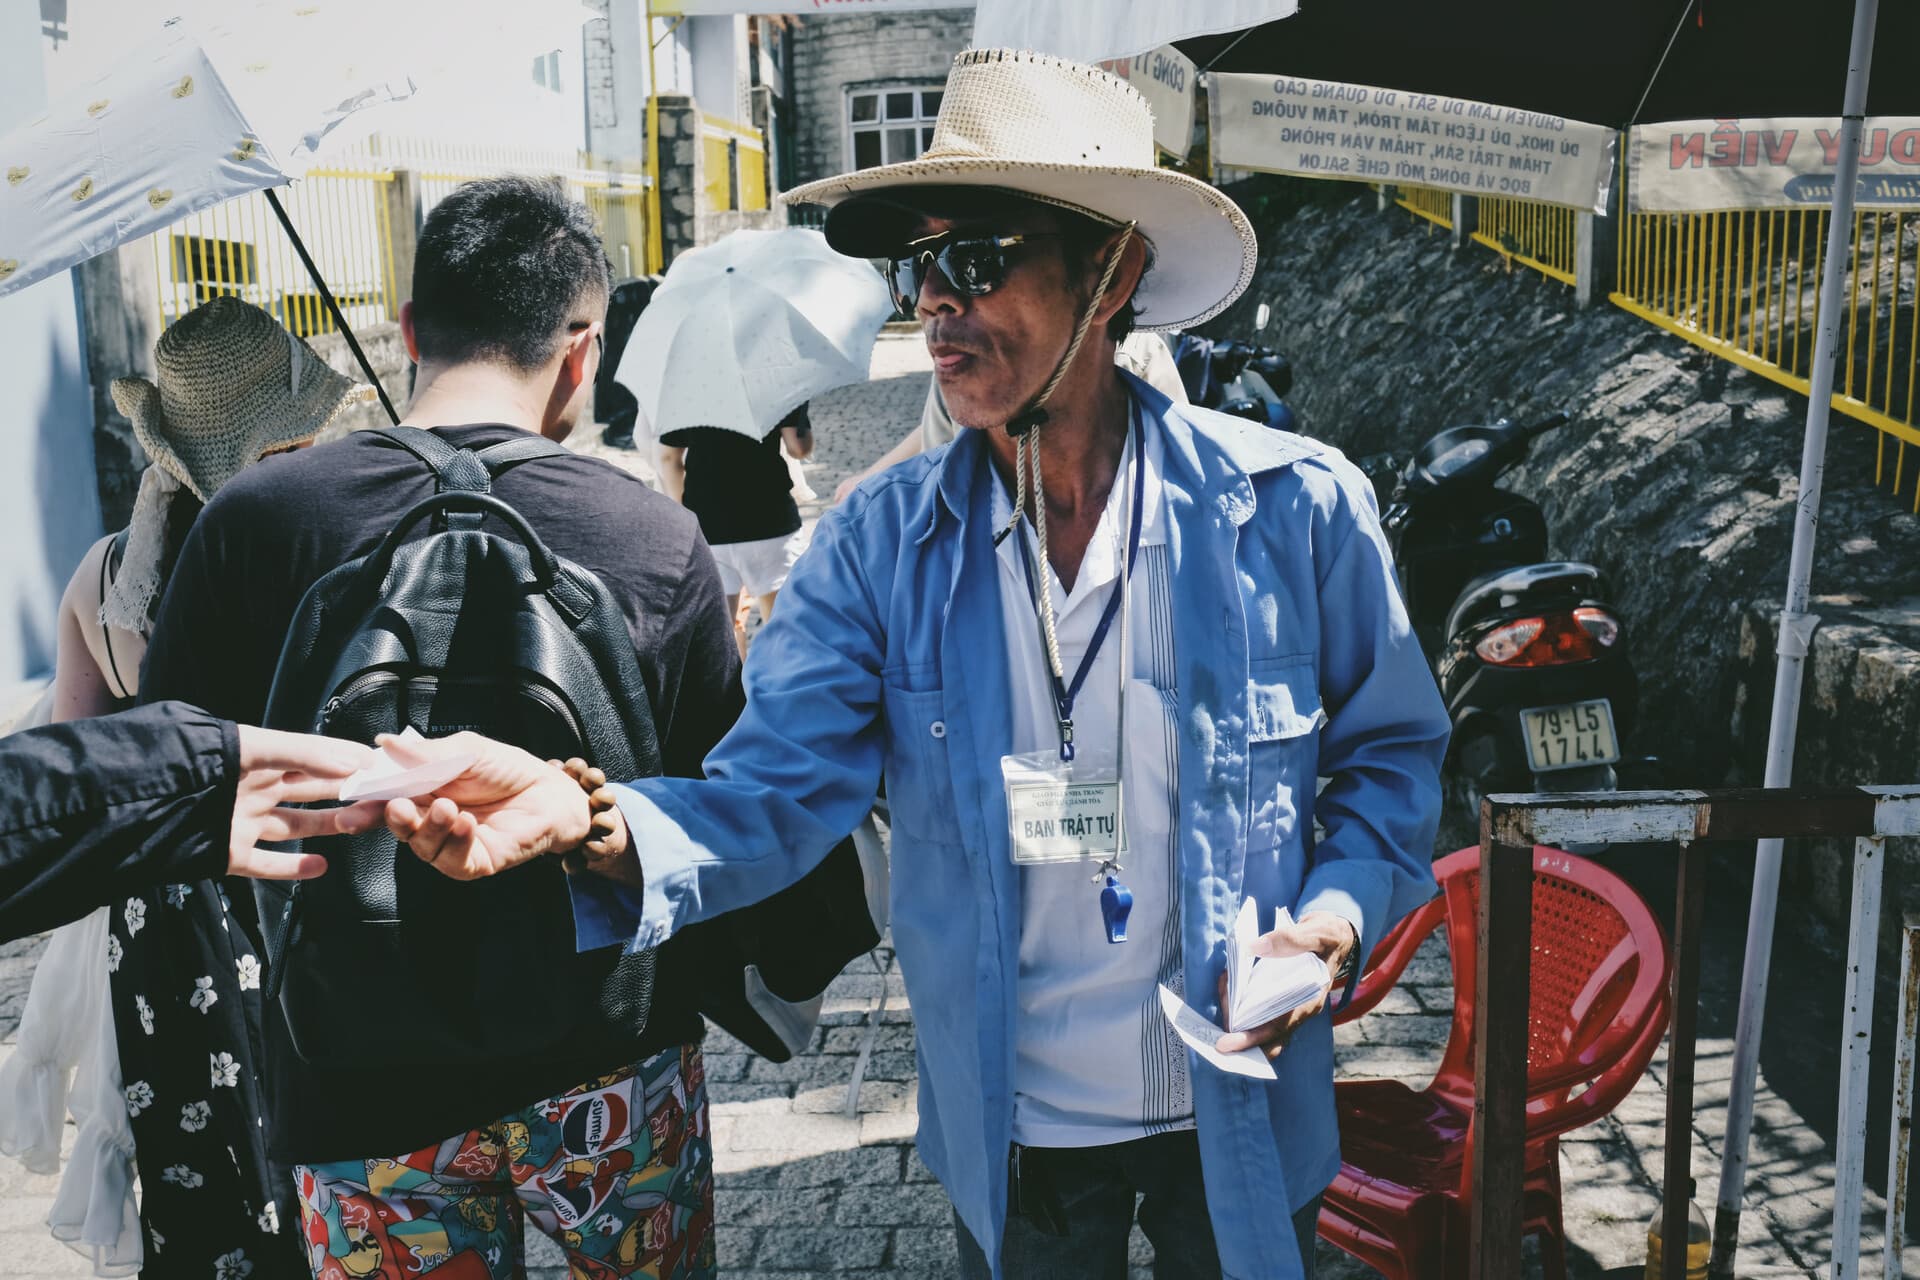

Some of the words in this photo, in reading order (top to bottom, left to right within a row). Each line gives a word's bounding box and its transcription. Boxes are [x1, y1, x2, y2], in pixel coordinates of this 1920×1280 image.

[1540, 734, 1606, 766] 1744
[1024, 818, 1056, 840] BAN
[1059, 813, 1093, 841] TRẬT
[1096, 812, 1115, 839] TỰ
